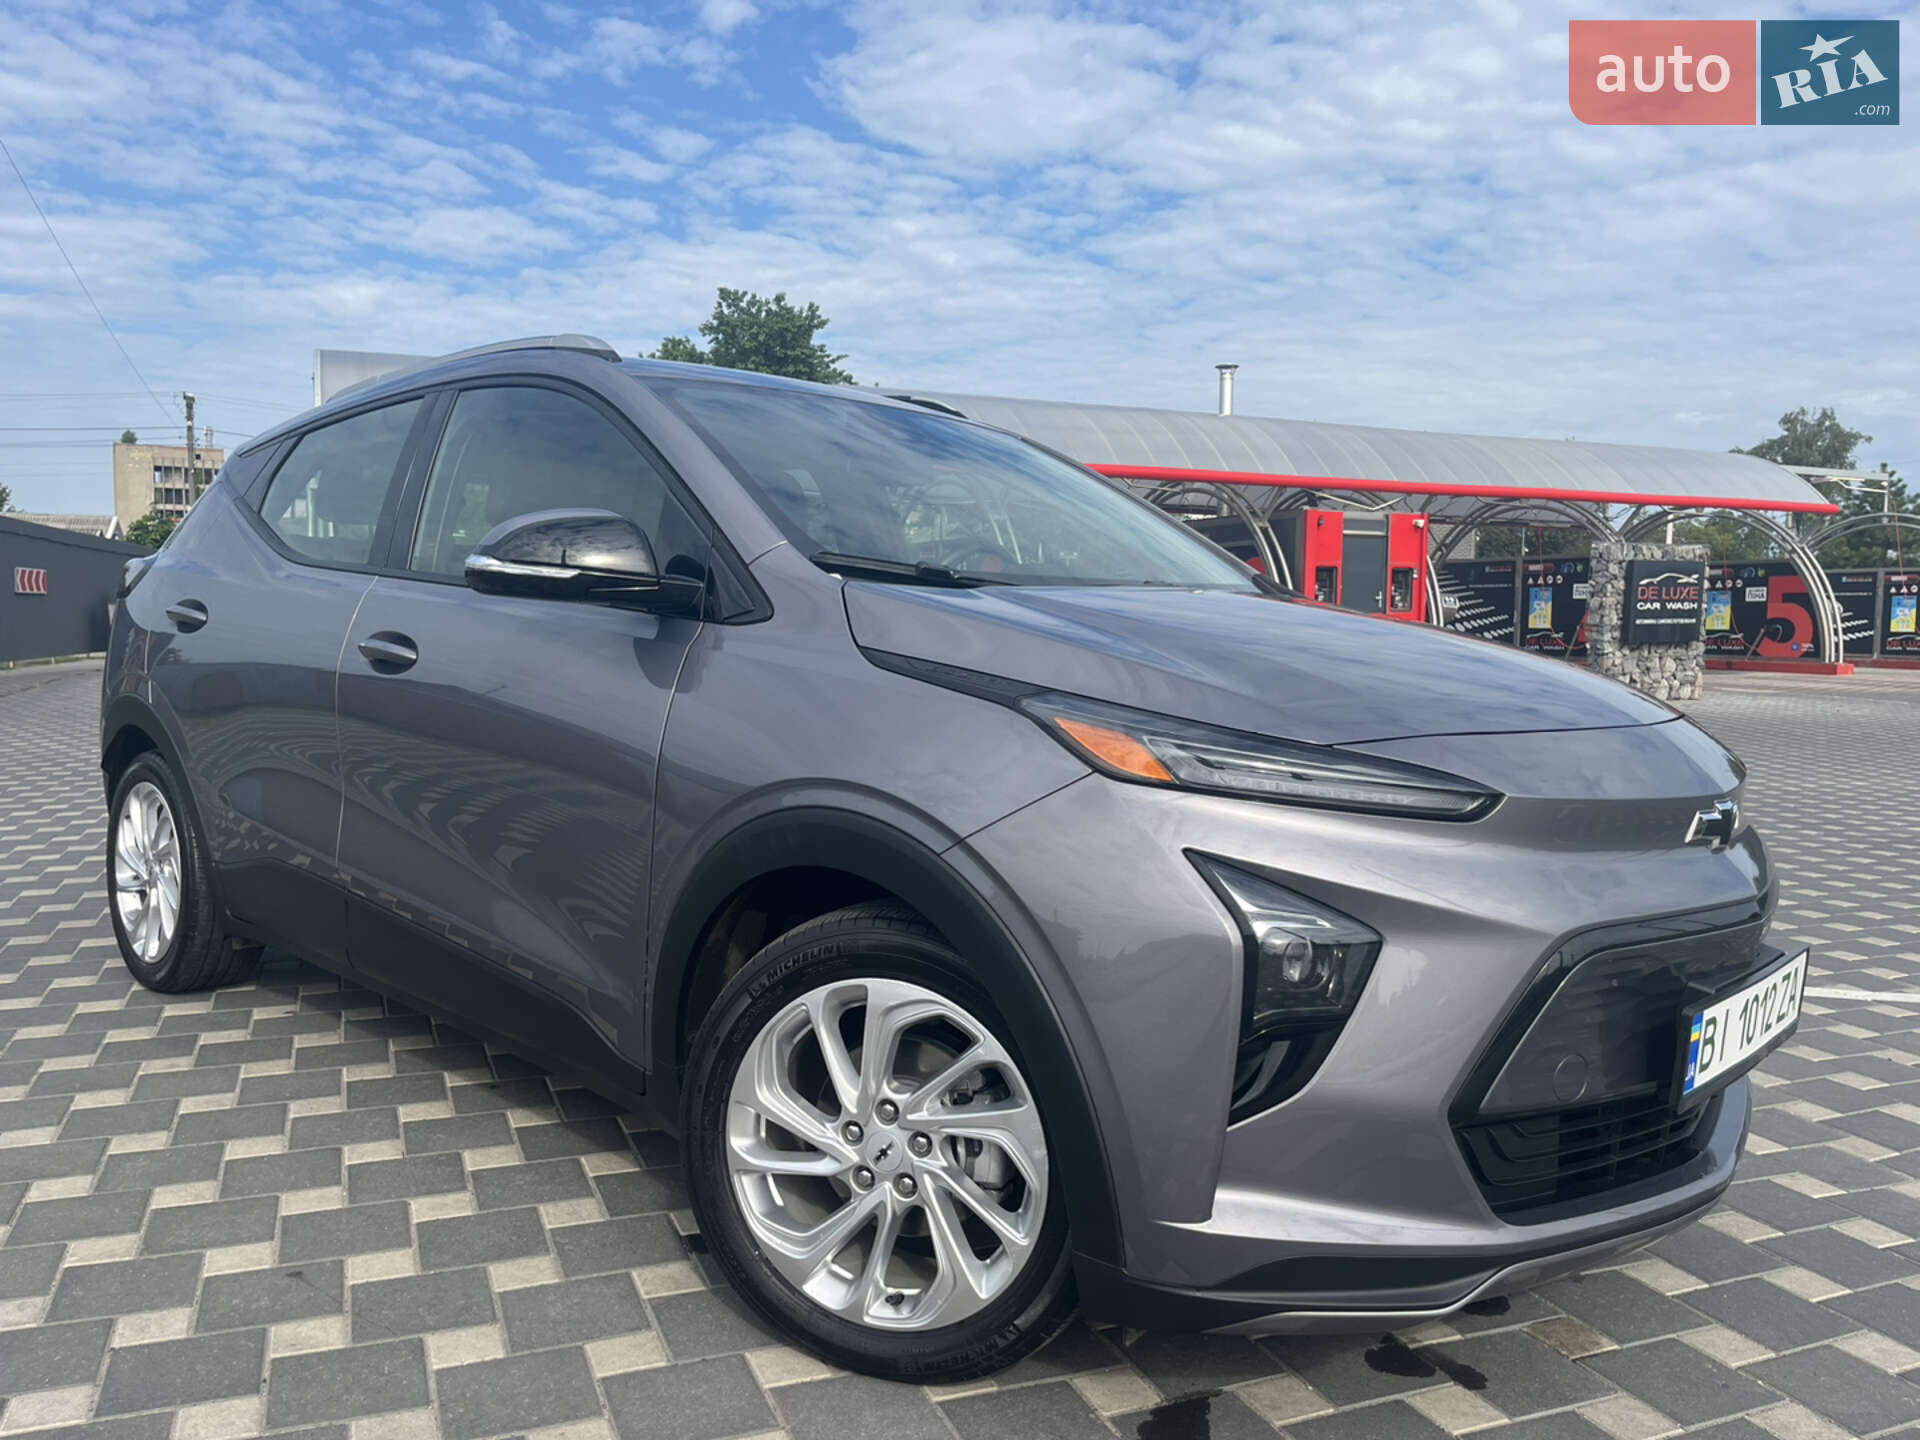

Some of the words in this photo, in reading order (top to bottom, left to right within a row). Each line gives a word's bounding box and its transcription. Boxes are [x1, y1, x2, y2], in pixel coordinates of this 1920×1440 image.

[1636, 602, 1661, 610] CAR
[1665, 601, 1698, 610] WASH
[1638, 586, 1660, 601] DE
[1662, 586, 1700, 601] LUXE
[1757, 576, 1814, 658] 5
[1698, 1008, 1729, 1074] BI
[1739, 983, 1777, 1050] 1012
[1776, 966, 1799, 1025] ZA
